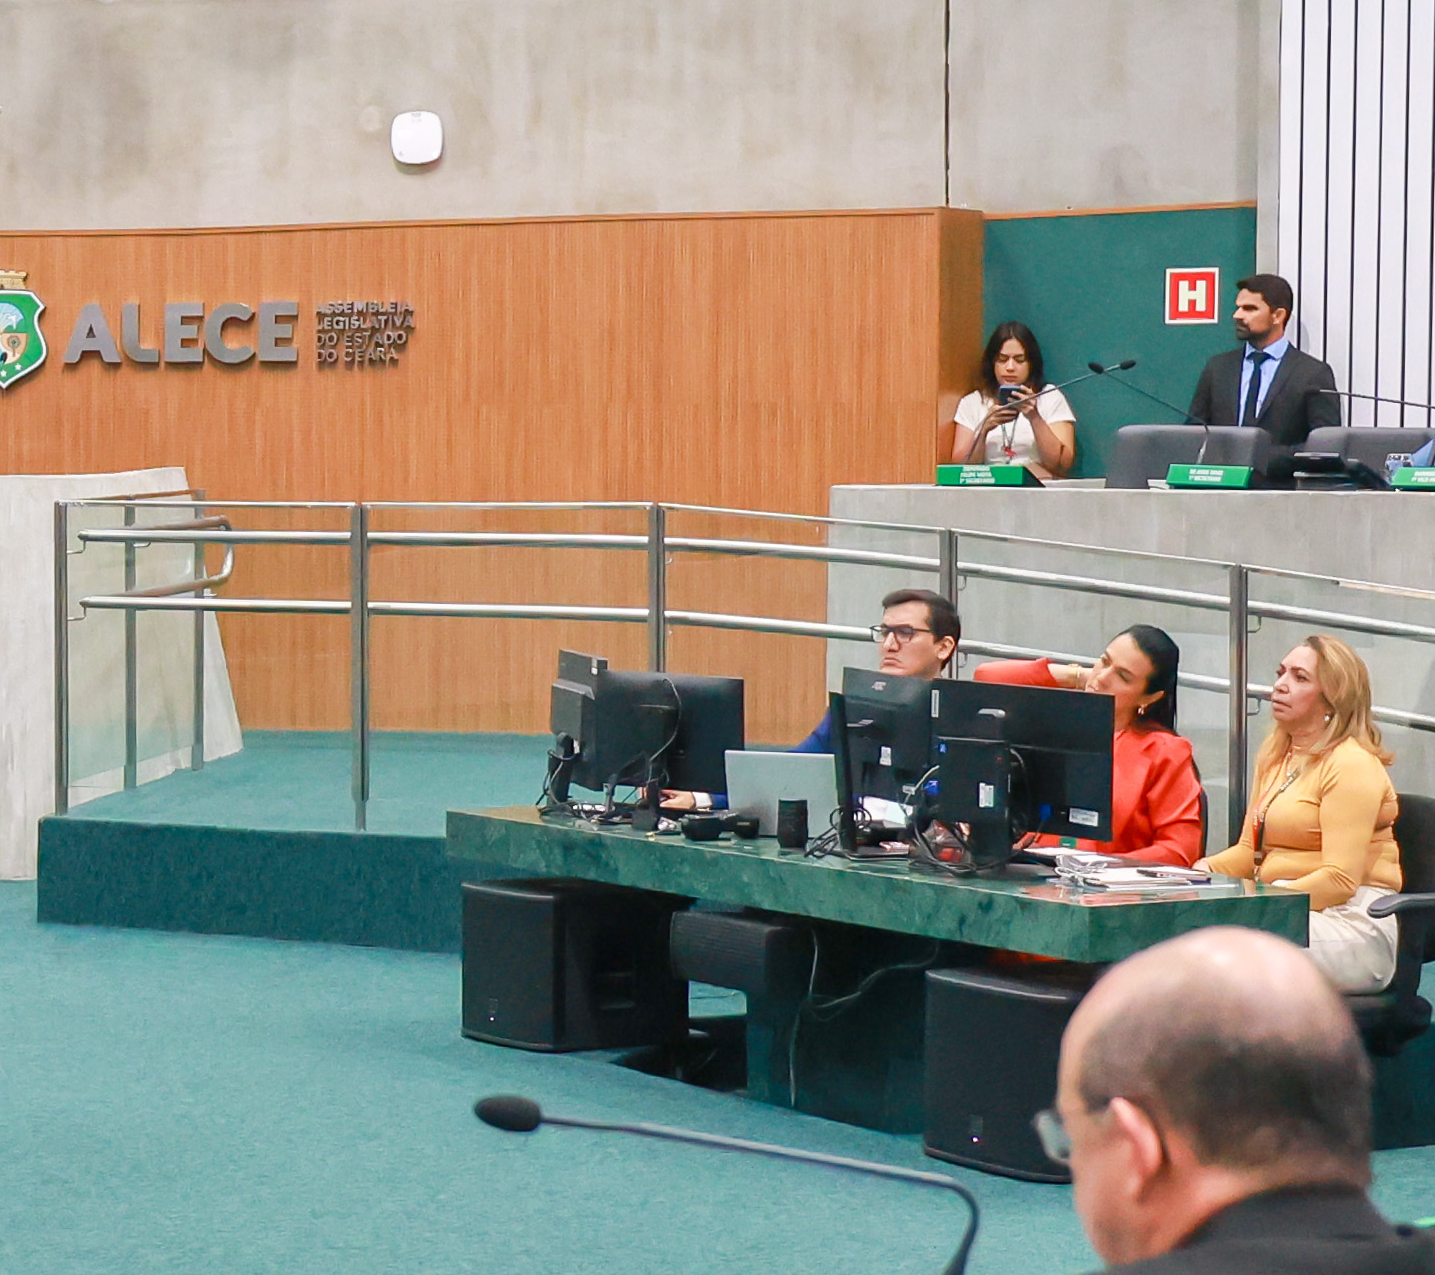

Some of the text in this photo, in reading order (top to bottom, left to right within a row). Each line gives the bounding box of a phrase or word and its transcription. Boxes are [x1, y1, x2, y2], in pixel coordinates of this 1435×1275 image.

[1179, 280, 1207, 313] H
[316, 300, 414, 314] ASSEMBLEIA
[316, 315, 415, 330] LEGISLATIVA
[63, 301, 299, 364] ALECE
[316, 330, 407, 345] DO ESTADO
[317, 348, 338, 362] DO
